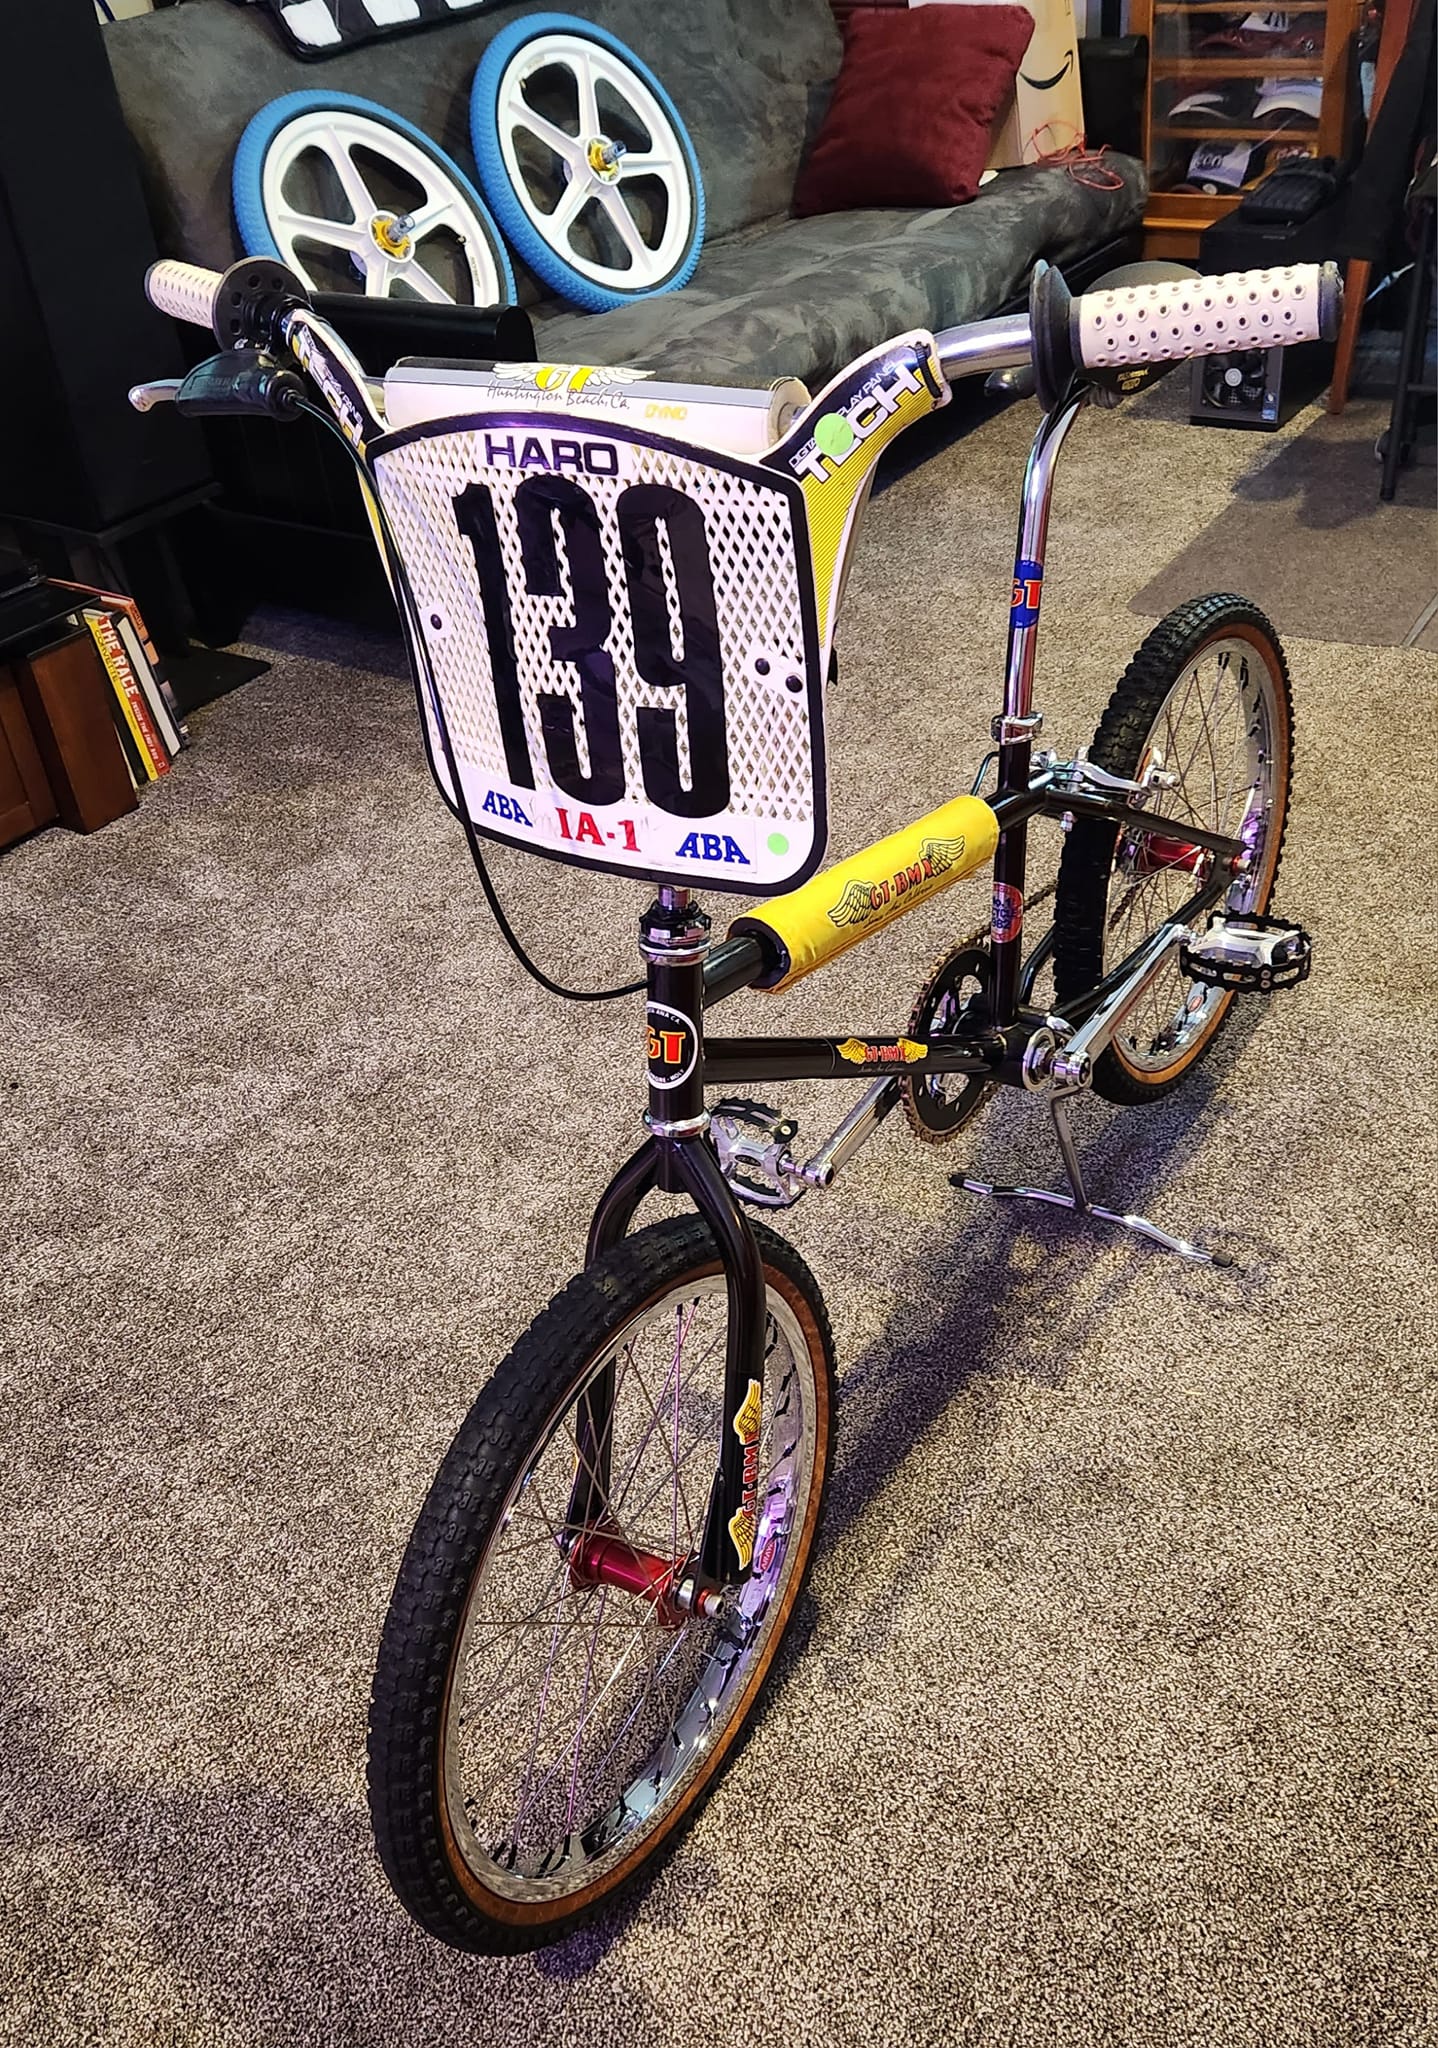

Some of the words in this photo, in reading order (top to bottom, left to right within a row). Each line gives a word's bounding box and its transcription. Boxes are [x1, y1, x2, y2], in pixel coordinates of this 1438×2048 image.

[486, 380, 563, 408] Huntington
[485, 434, 620, 476] HARO
[789, 436, 817, 468] DIGITA
[1011, 578, 1043, 609] GT
[95, 630, 119, 682] CORVETTE
[99, 619, 121, 652] THE
[112, 654, 140, 699] RACE
[452, 473, 731, 818] 139
[140, 722, 149, 733] THE
[482, 790, 534, 828] ABA
[555, 807, 642, 852] IA-1
[675, 832, 751, 865] ABA
[646, 1025, 686, 1064] GT
